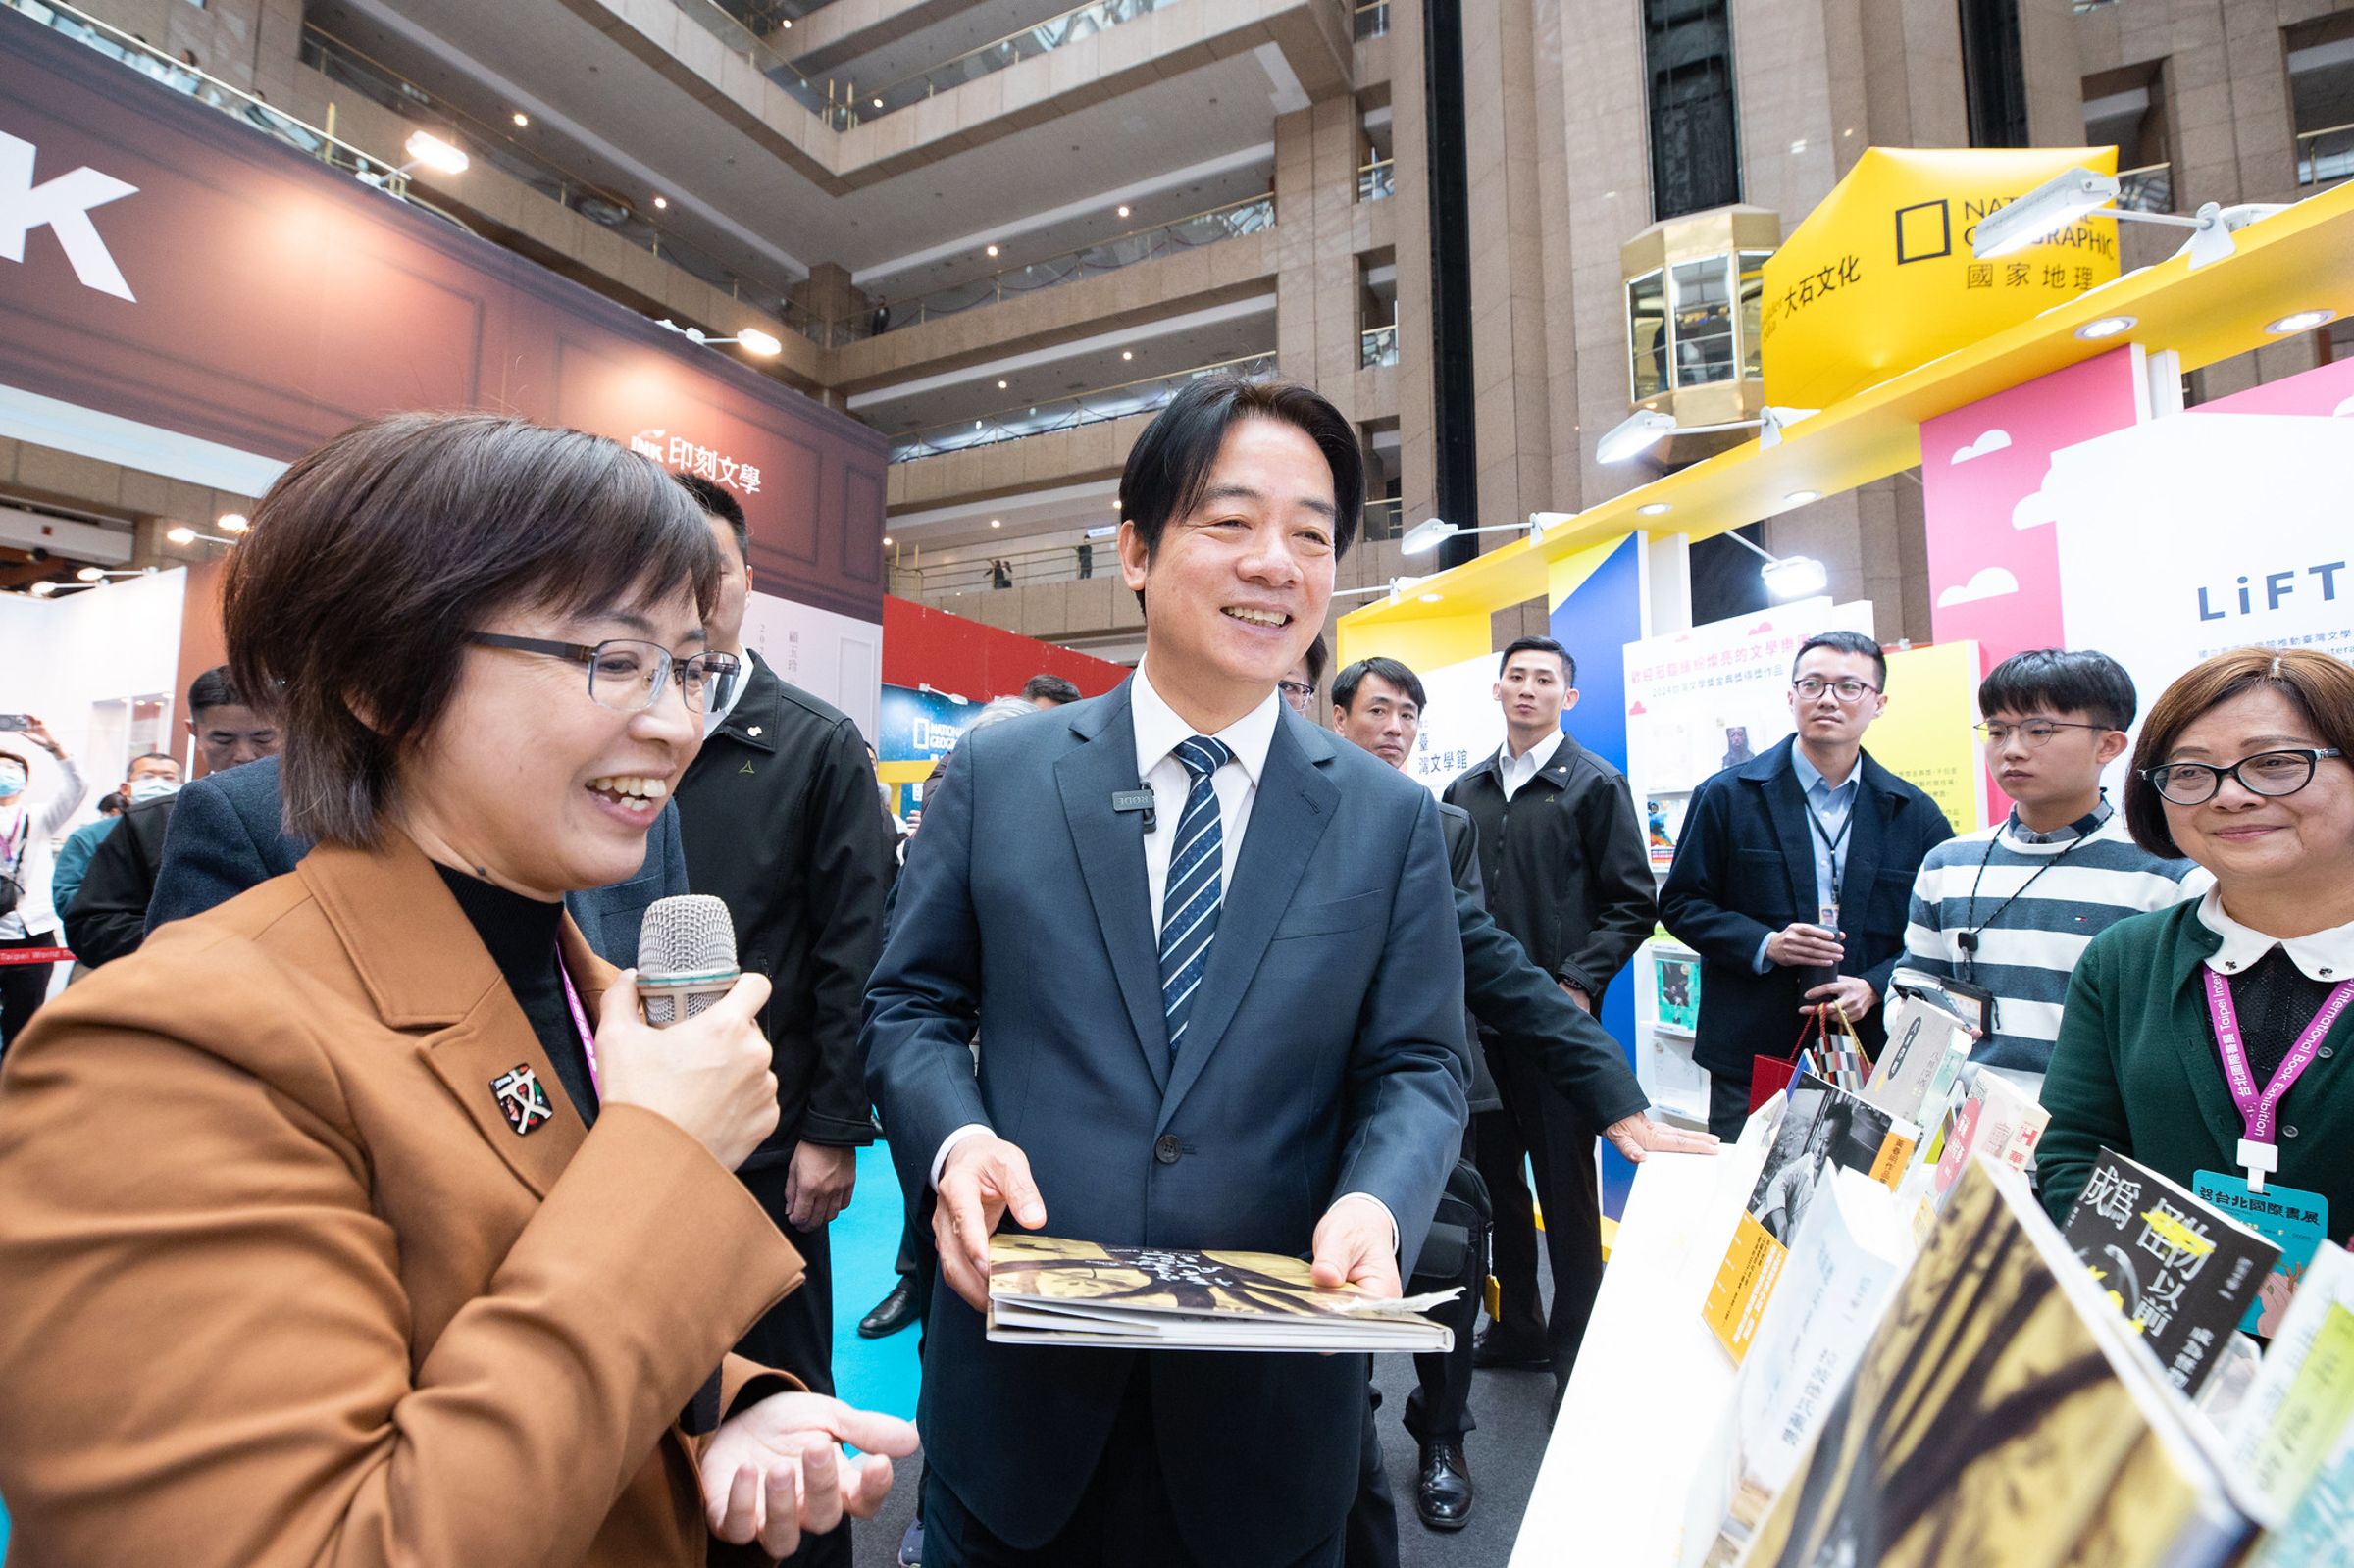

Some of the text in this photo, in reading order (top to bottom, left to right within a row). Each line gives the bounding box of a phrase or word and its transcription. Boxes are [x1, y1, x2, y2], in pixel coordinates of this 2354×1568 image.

[1785, 255, 1861, 319] 大石文化
[1967, 262, 2094, 291] 國家地理
[668, 435, 761, 494] 印刻文學
[2198, 561, 2346, 622] LiFT
[1419, 748, 1468, 775] 灣文學館
[2214, 998, 2232, 1032] Taipei
[2254, 987, 2354, 1138] International Book Exhibition
[2215, 1190, 2320, 1226] 台北國際書展
